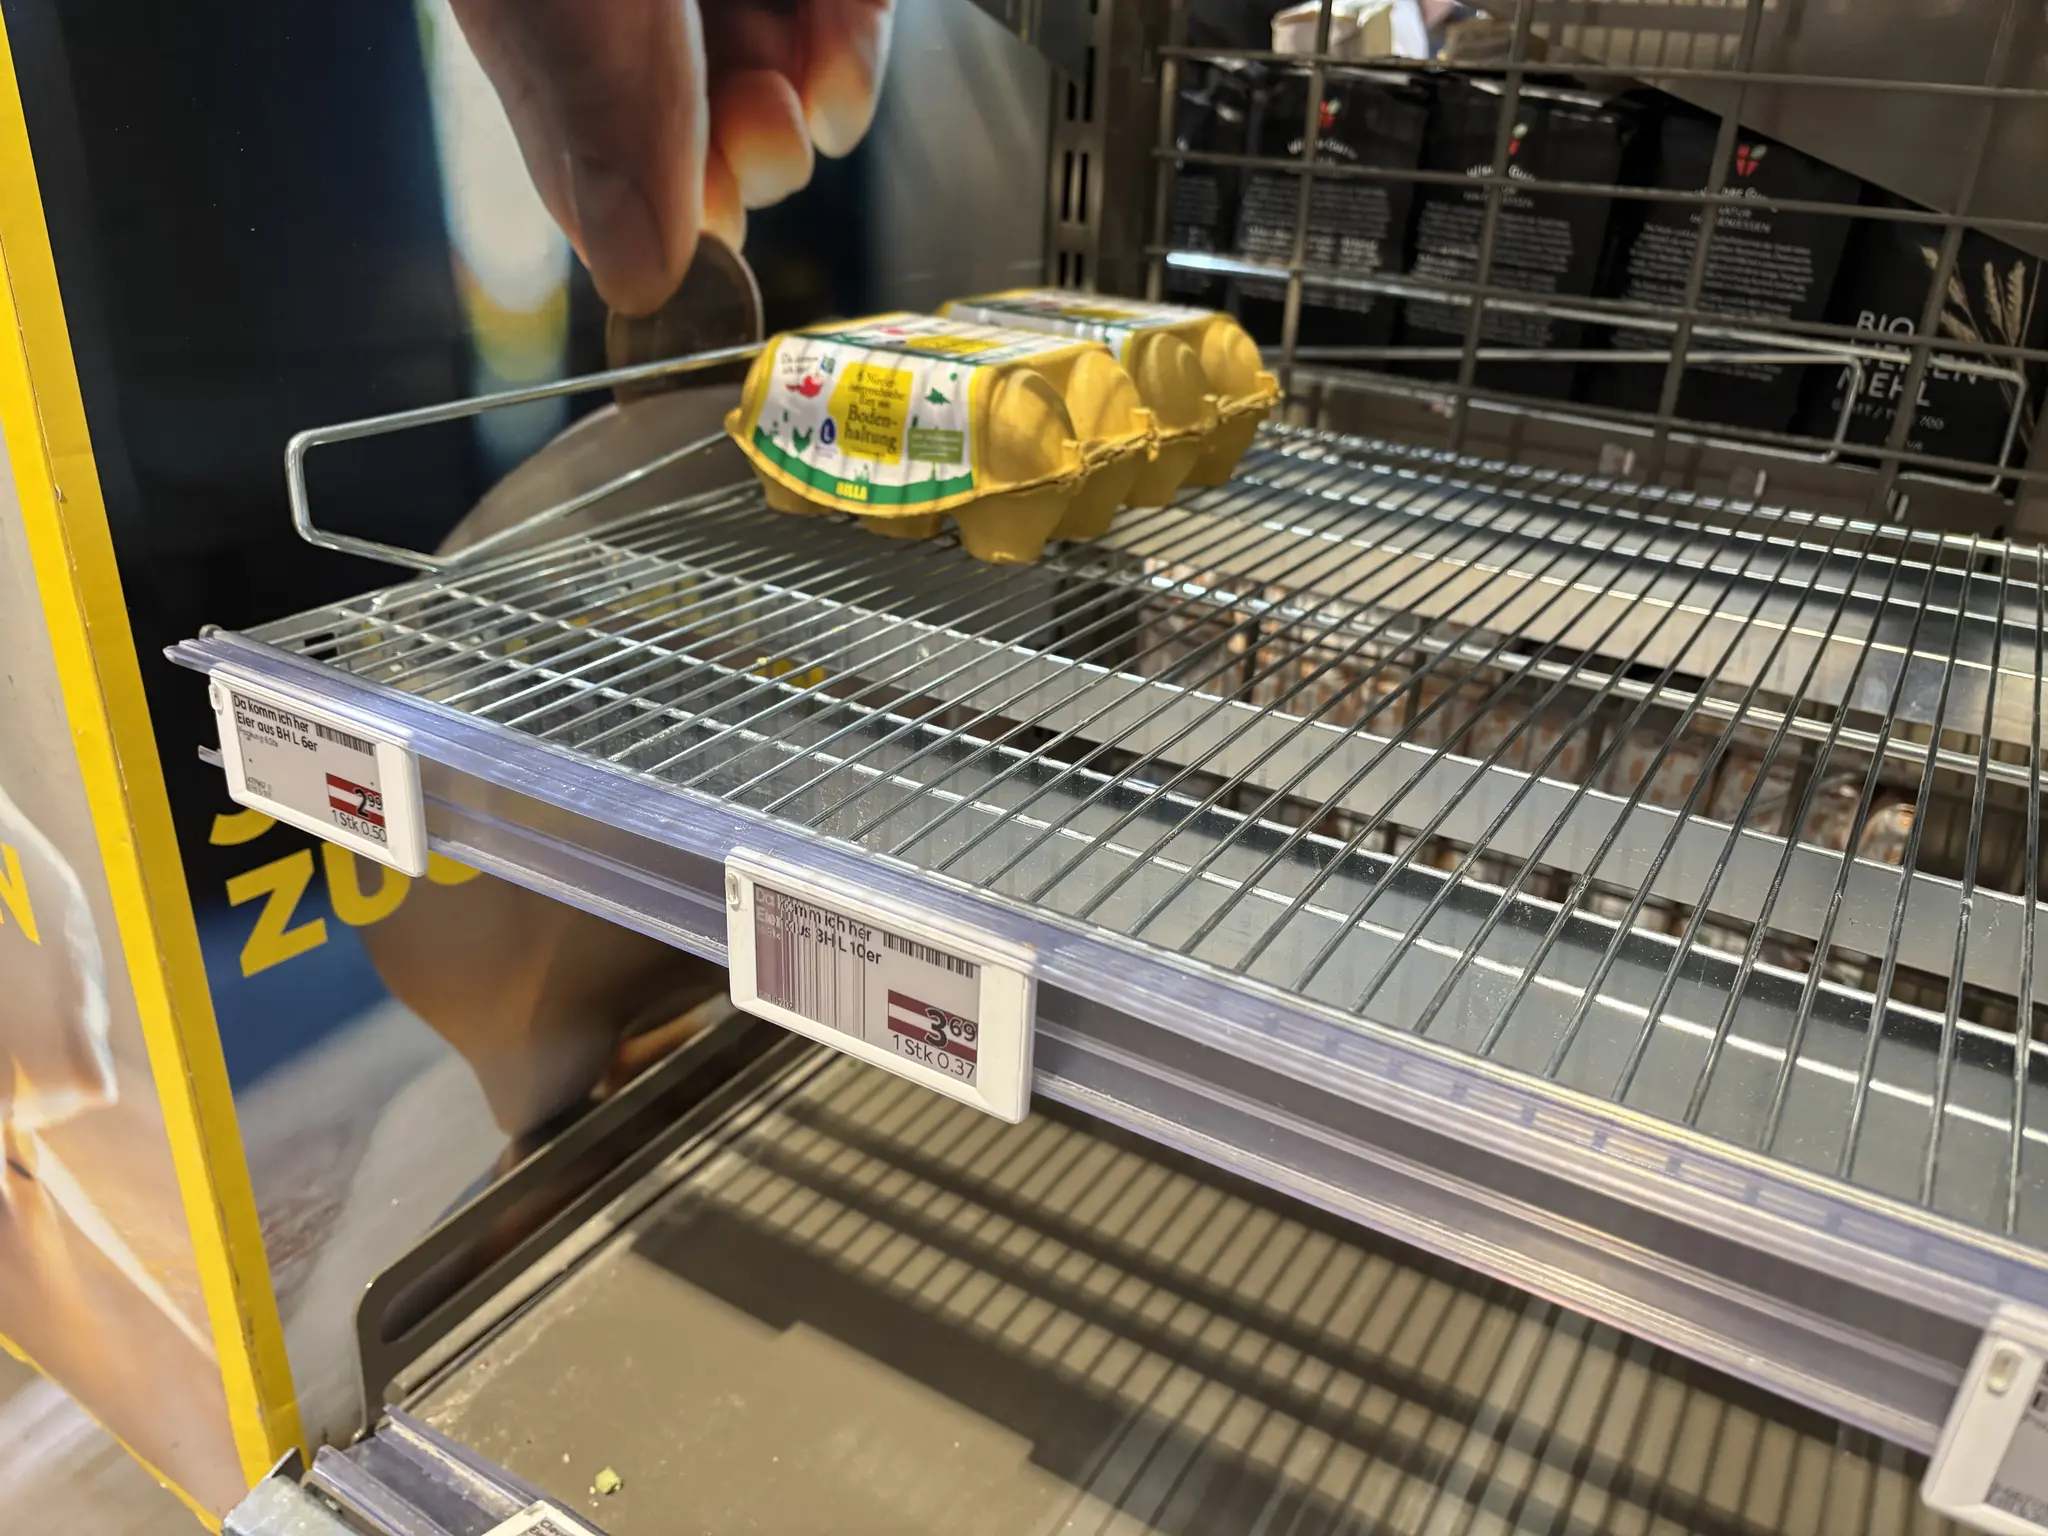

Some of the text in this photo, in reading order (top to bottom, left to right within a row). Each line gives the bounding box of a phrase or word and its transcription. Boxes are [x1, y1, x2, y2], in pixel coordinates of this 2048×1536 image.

[233, 694, 309, 733] Da komm ich her
[236, 711, 255, 728] Eier
[257, 721, 275, 736] aus
[276, 725, 291, 742] BH
[292, 731, 300, 746] L
[301, 735, 318, 752] 6er
[332, 809, 387, 843] 1 Stk 0.50
[824, 909, 846, 933] ich
[848, 918, 872, 942] her
[838, 935, 847, 953] L
[850, 940, 882, 965] 10er
[893, 1034, 976, 1080] 1 Stk 0.37
